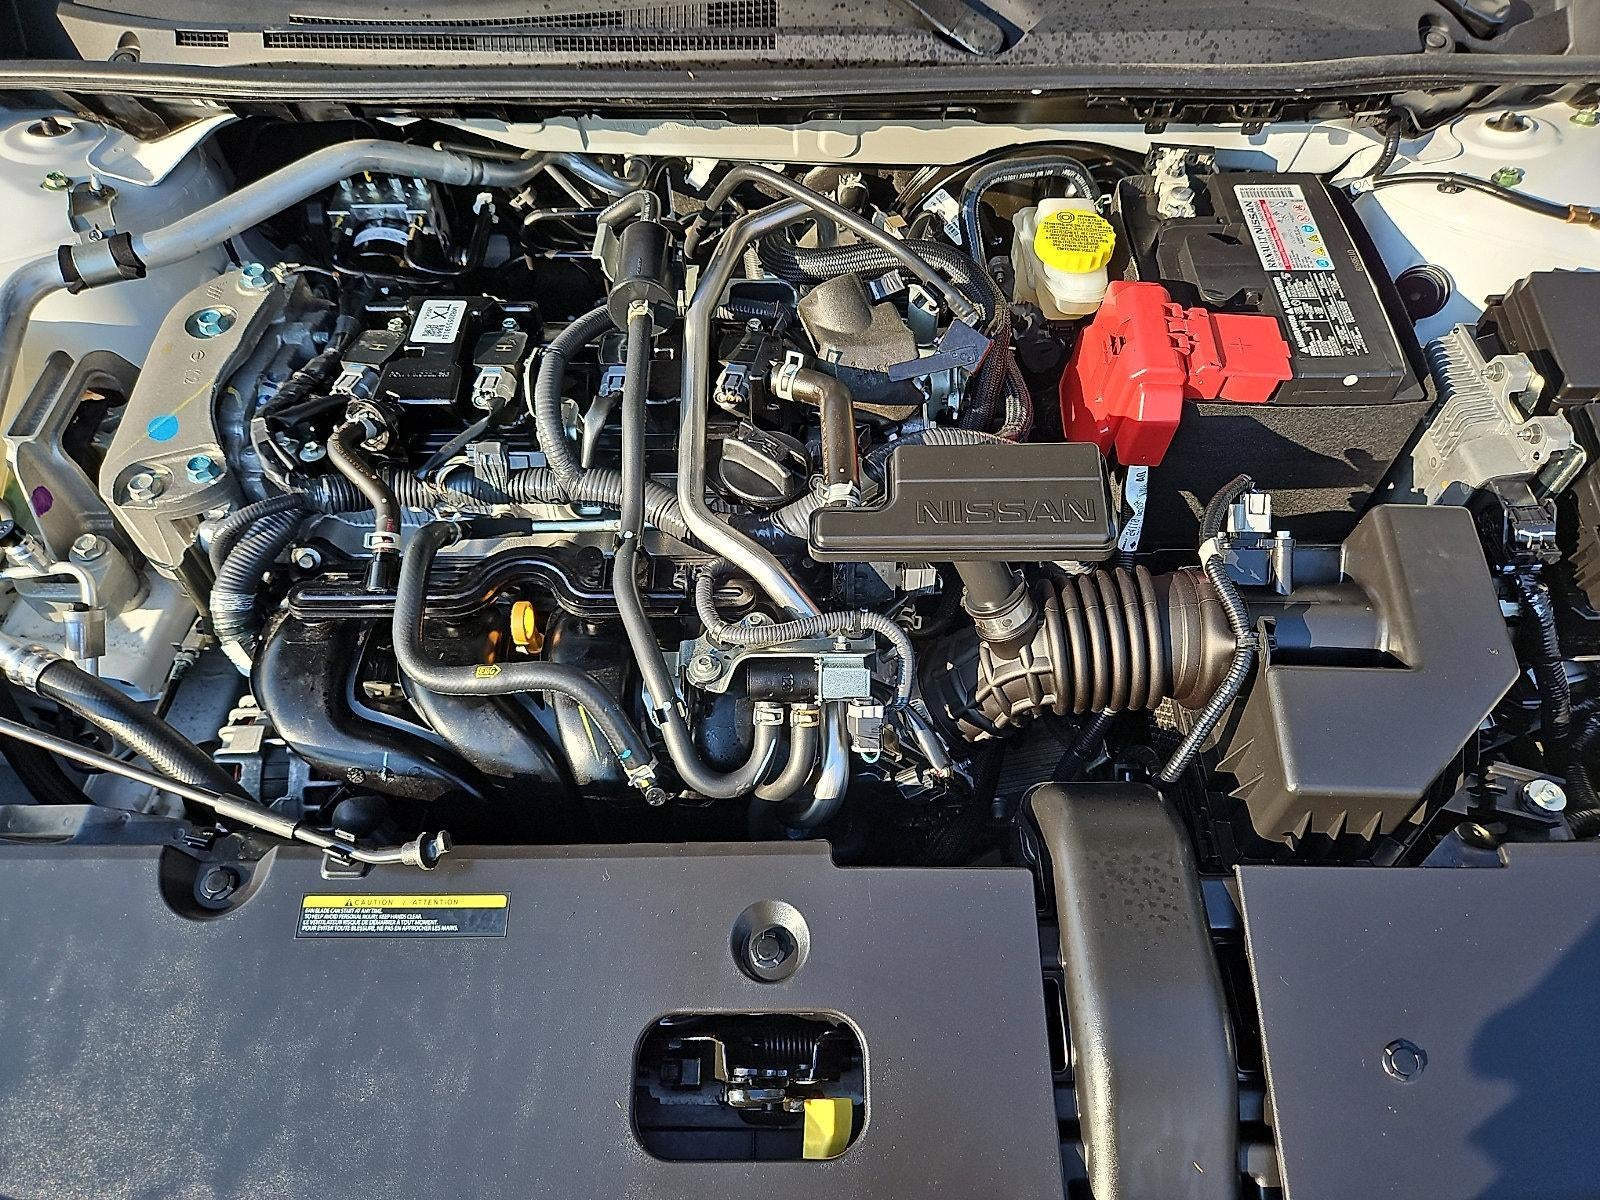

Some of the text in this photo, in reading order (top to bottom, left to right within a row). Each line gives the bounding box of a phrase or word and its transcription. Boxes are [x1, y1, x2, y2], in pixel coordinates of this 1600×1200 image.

[1243, 201, 1264, 235] NISSAN
[430, 304, 452, 320] TX
[915, 499, 1097, 525] NISSAN
